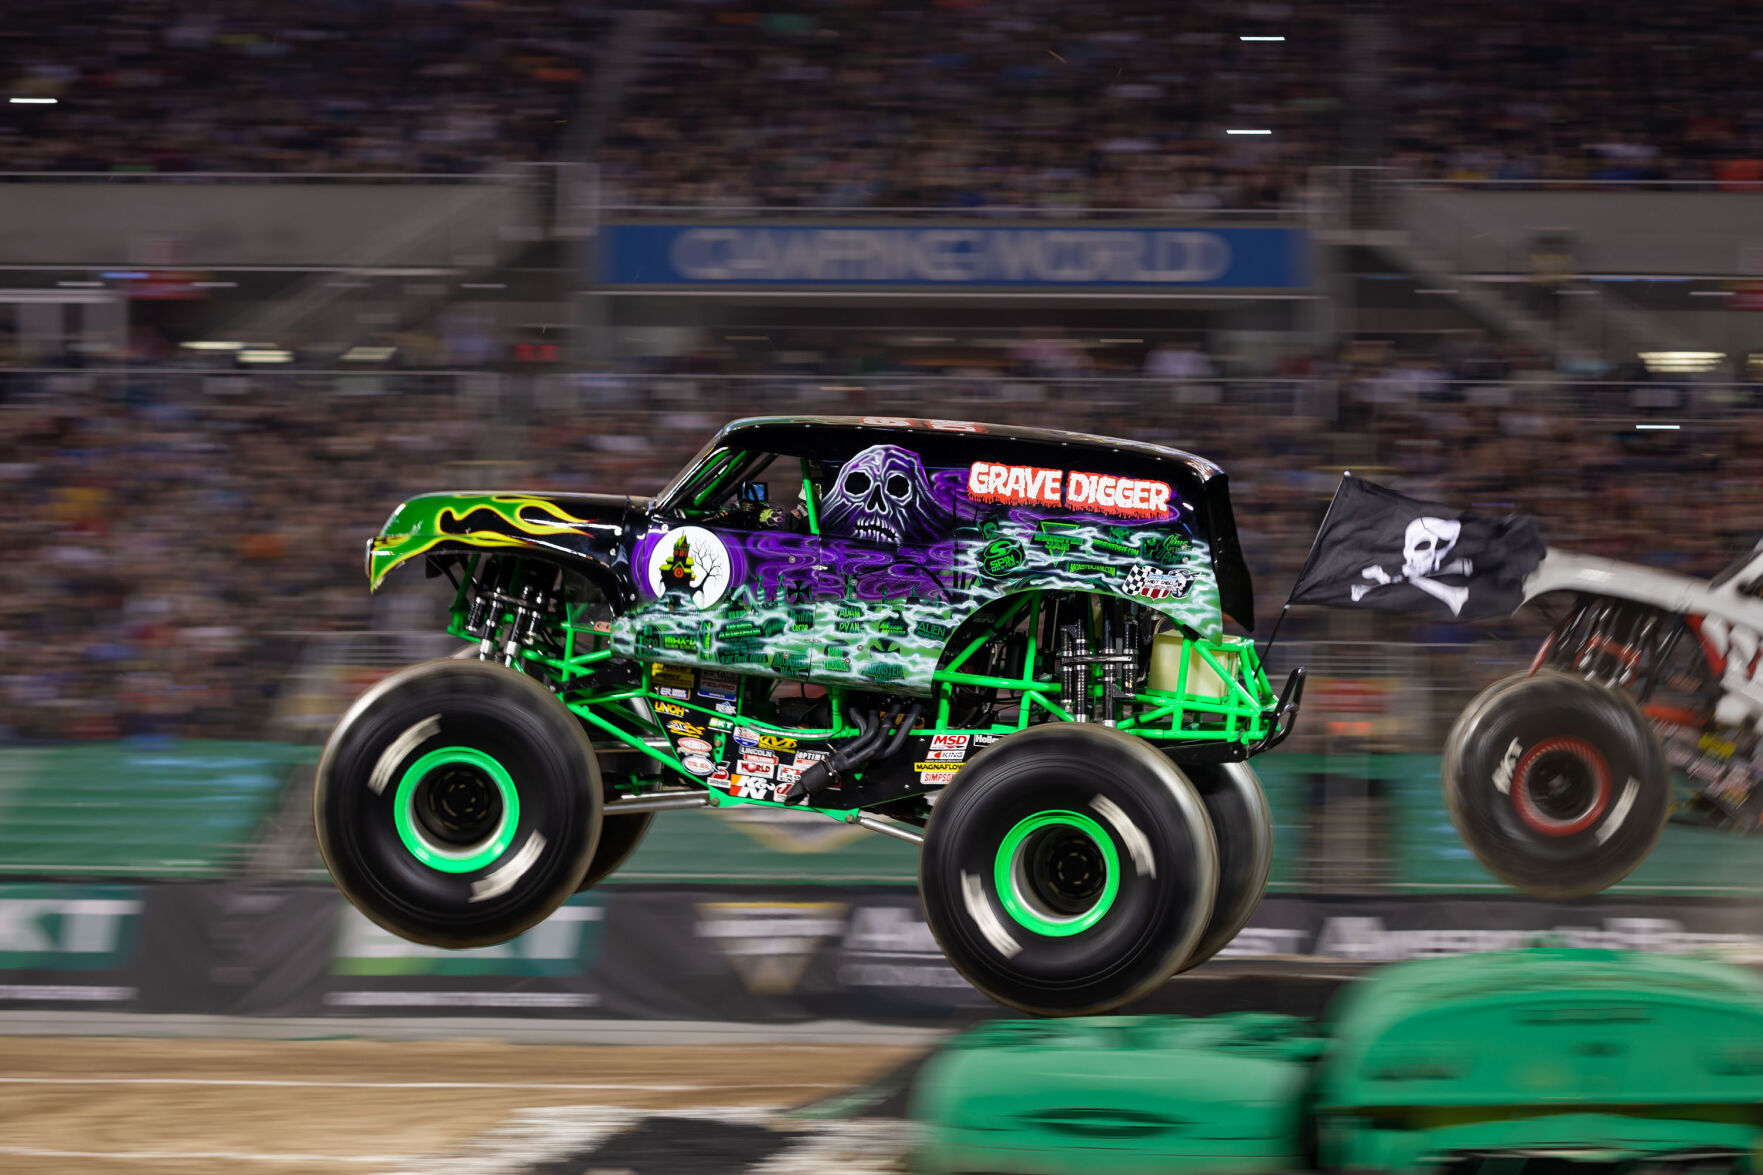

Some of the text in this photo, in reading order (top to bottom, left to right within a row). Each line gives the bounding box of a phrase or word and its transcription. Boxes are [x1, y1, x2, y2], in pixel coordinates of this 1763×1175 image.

[969, 461, 1171, 517] GRAVE DIGGER
[990, 554, 1015, 568] SPIN
[839, 606, 860, 618] ADAM
[917, 621, 946, 638] ALIEN
[655, 701, 685, 717] UNOH
[934, 735, 967, 745] MSD
[975, 734, 1000, 744] Holle
[741, 747, 773, 758] LINCOLN
[737, 775, 776, 800] K&N
